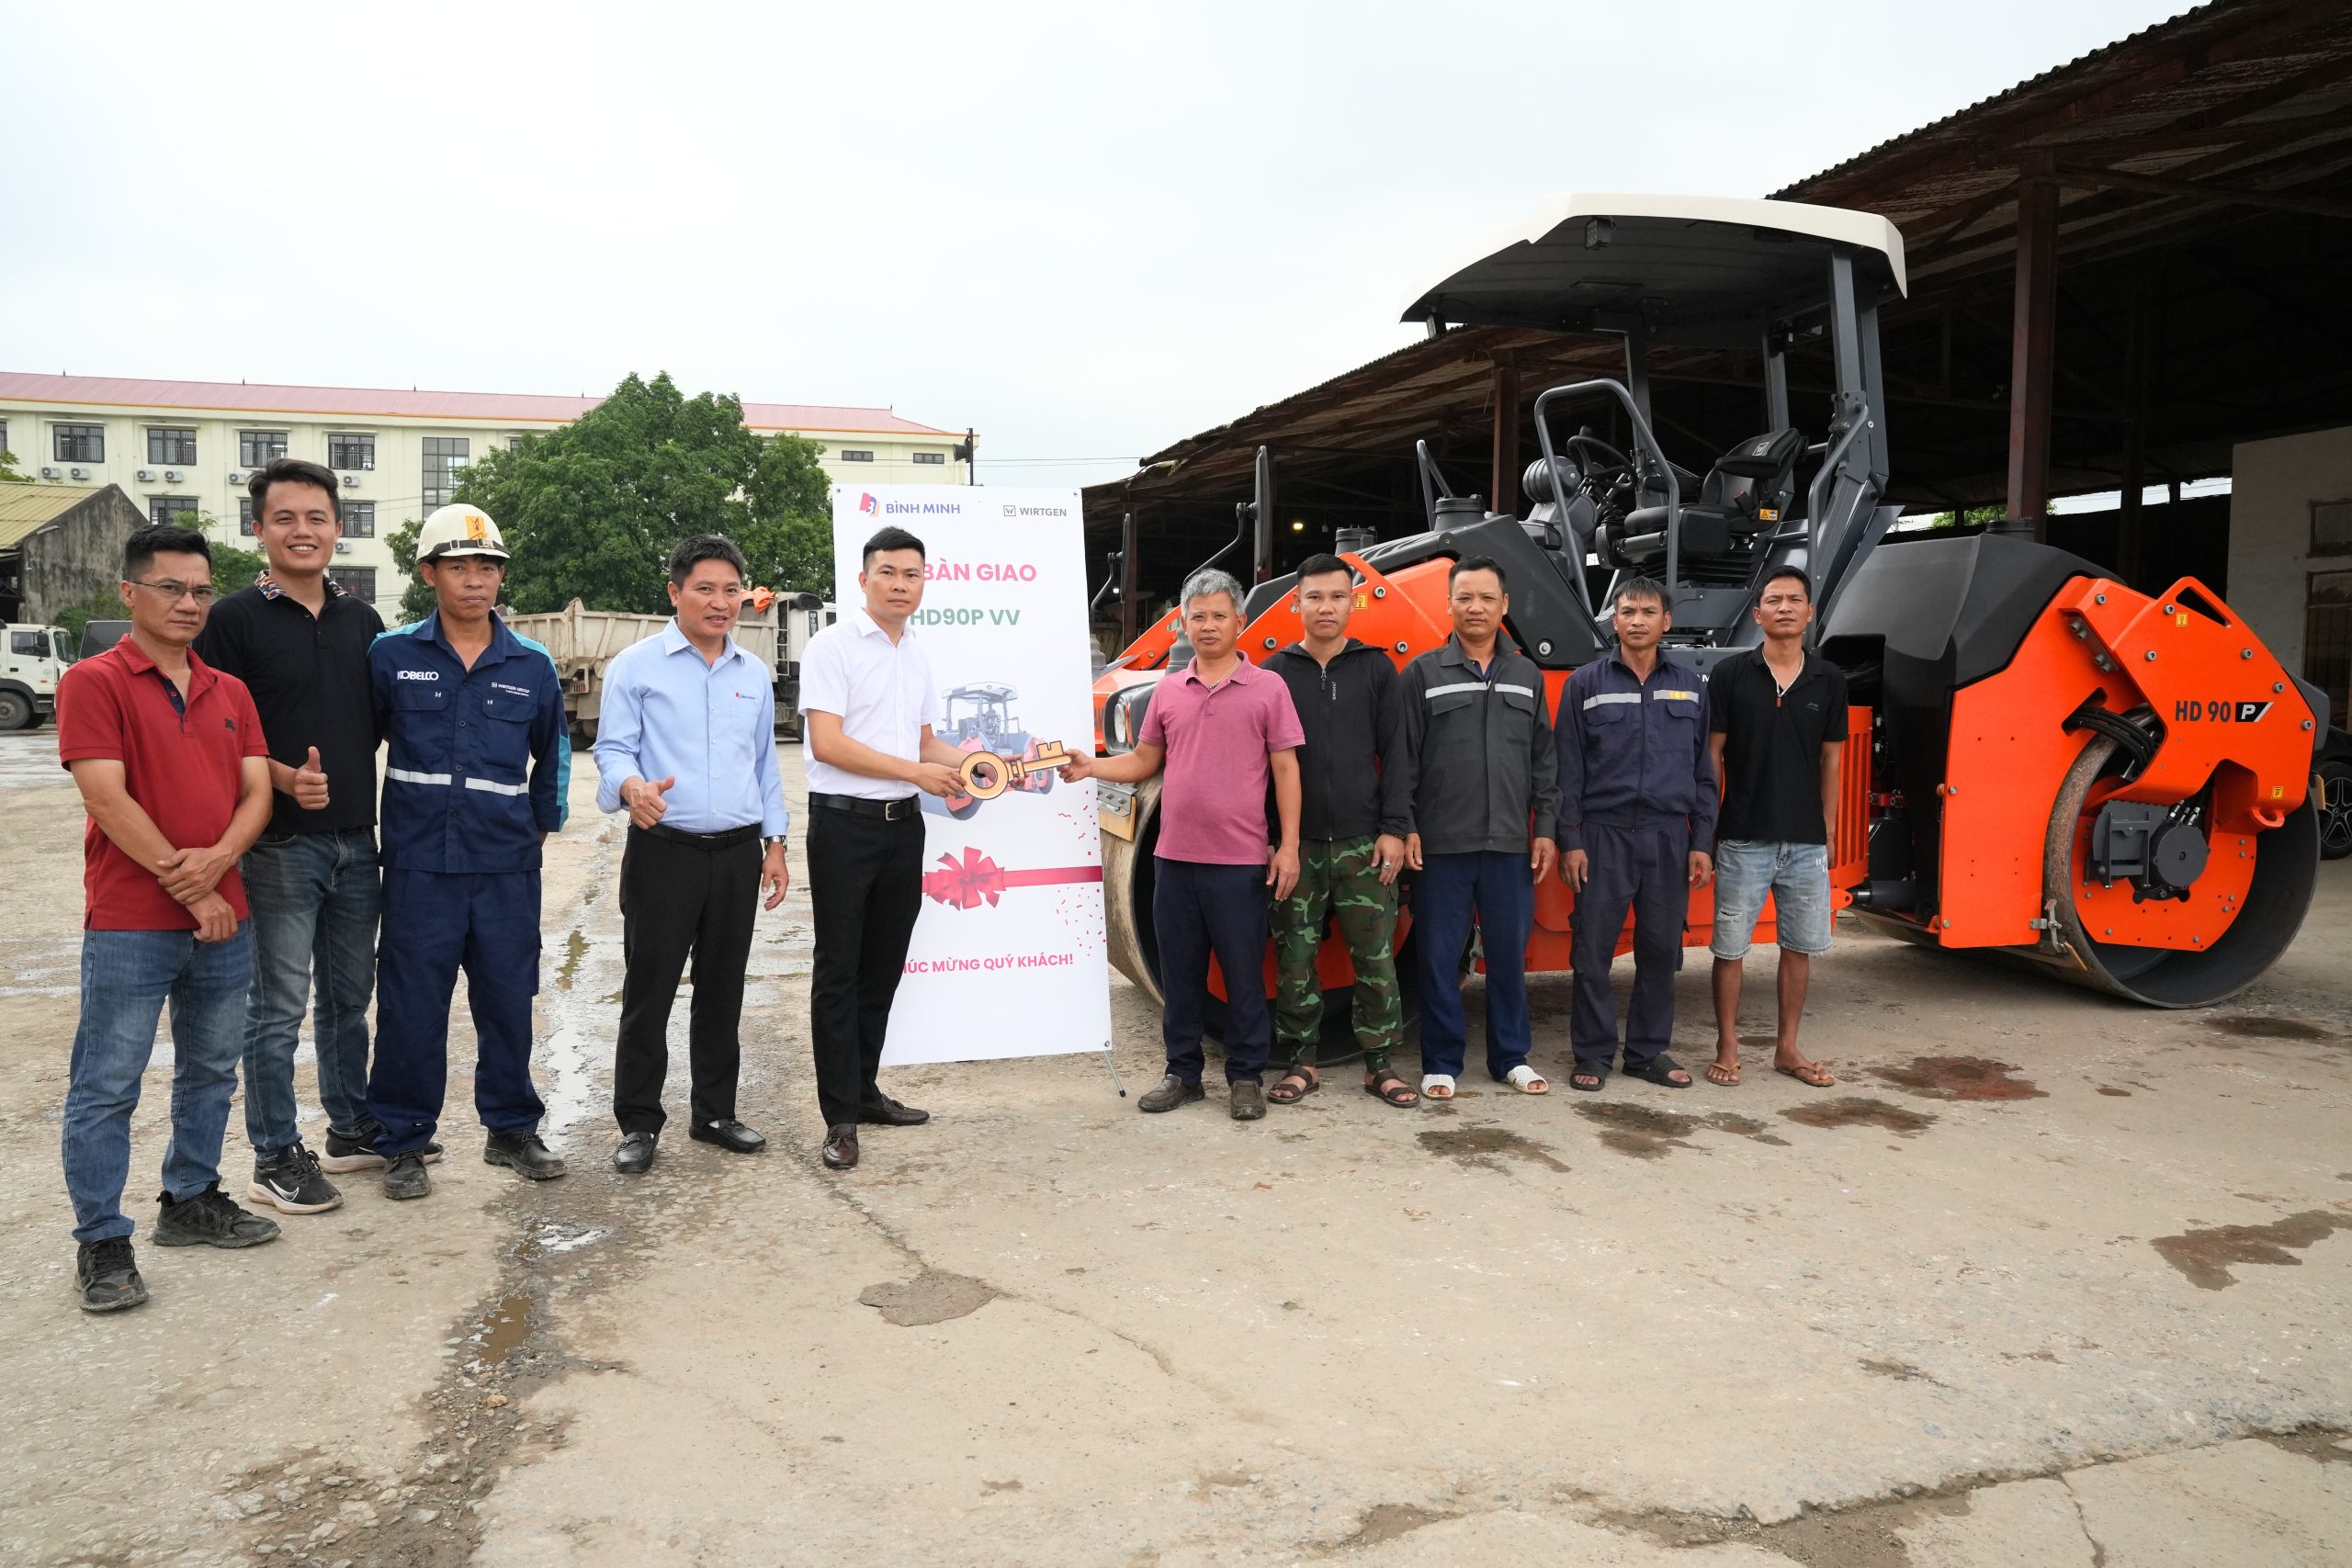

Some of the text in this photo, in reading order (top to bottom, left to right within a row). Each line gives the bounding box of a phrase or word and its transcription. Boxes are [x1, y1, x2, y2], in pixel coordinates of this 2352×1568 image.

[886, 500, 960, 513] BÌNH MINH
[1019, 507, 1067, 516] WIRTGEN
[924, 558, 1036, 581] BÀN GIAO
[910, 608, 1021, 626] HD90P VV
[397, 670, 439, 681] KOBELCO
[2175, 700, 2202, 721] HD
[2208, 701, 2231, 722] 90
[903, 952, 1073, 974] ÚC MỪNG QUÝ KHÁCH!
